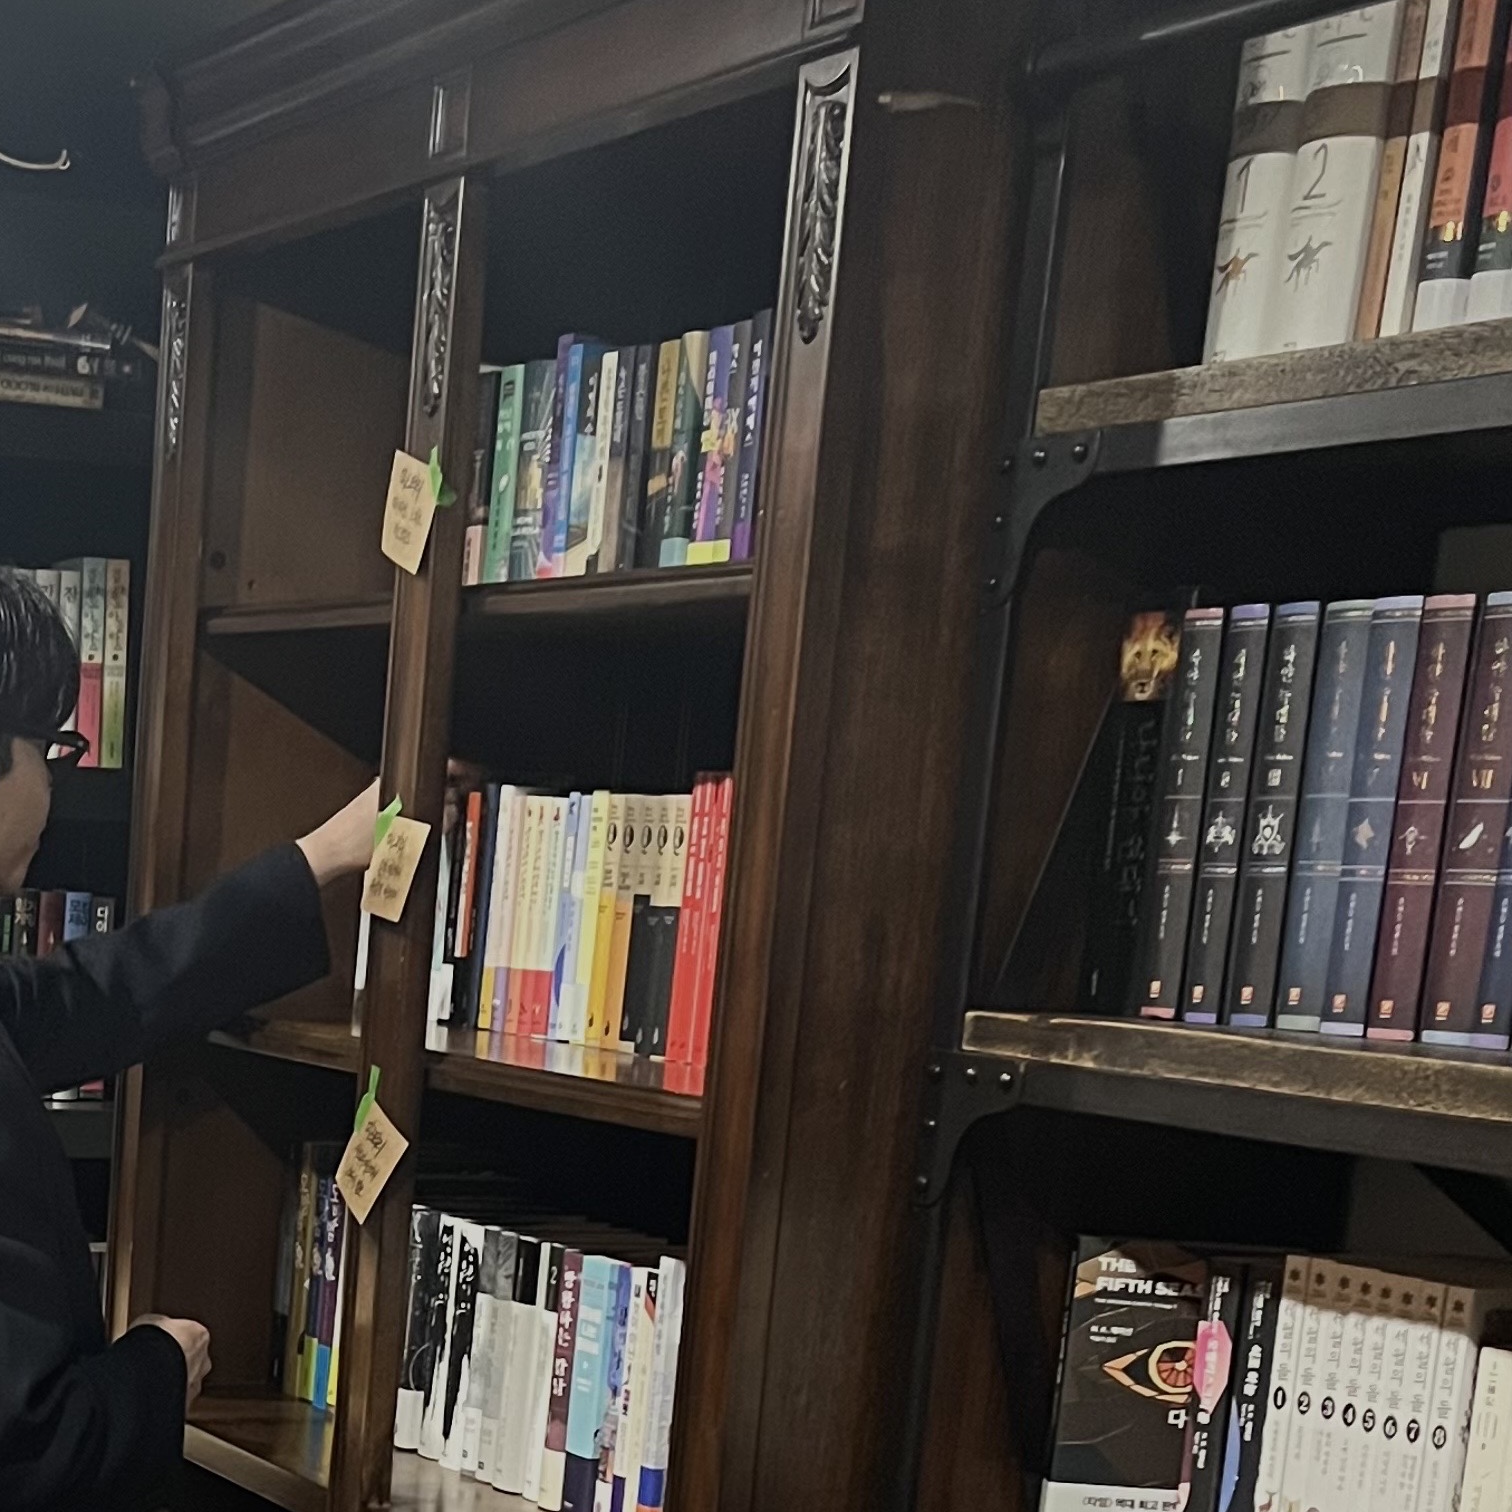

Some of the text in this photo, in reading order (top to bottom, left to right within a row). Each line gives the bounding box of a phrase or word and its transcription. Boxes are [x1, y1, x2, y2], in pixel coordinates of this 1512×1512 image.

[1302, 142, 1329, 201] 2
[1097, 1257, 1137, 1273] THE
[1095, 1277, 1153, 1295] FIFTH
